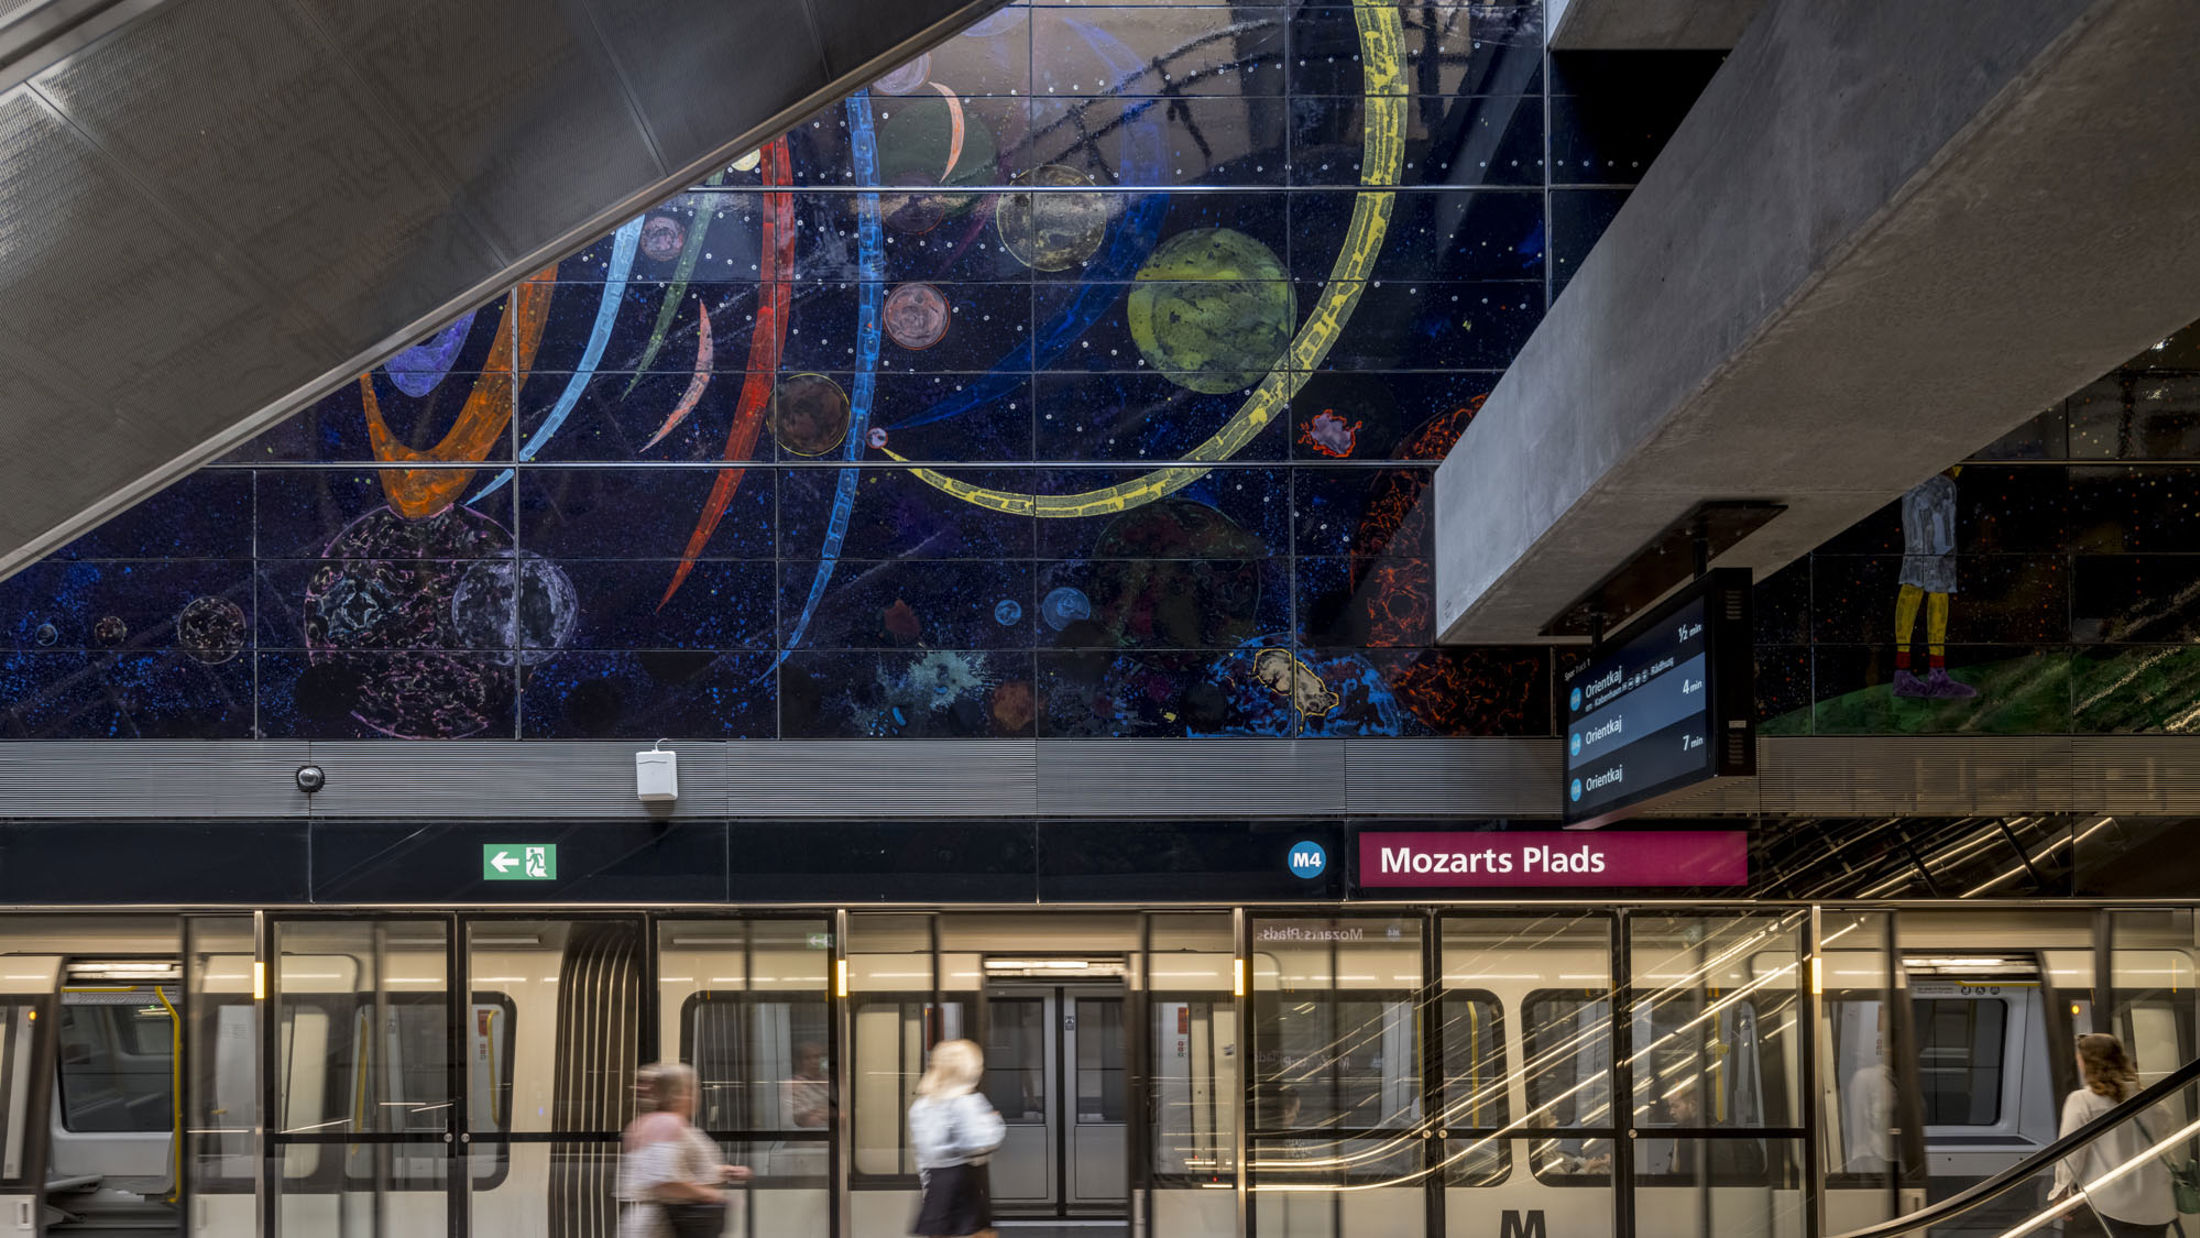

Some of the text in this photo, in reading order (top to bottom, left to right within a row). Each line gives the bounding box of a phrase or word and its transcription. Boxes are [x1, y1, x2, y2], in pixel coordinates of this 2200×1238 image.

[1585, 665, 1622, 698] Orientkaj
[1682, 679, 1702, 694] 4 min
[1585, 714, 1622, 745] Orientkaj
[1682, 734, 1703, 751] 7 min
[1586, 764, 1623, 791] Orientkaj
[1293, 852, 1322, 867] M4
[1381, 845, 1605, 873] Mozarts Plads
[1500, 1210, 1546, 1238] M
